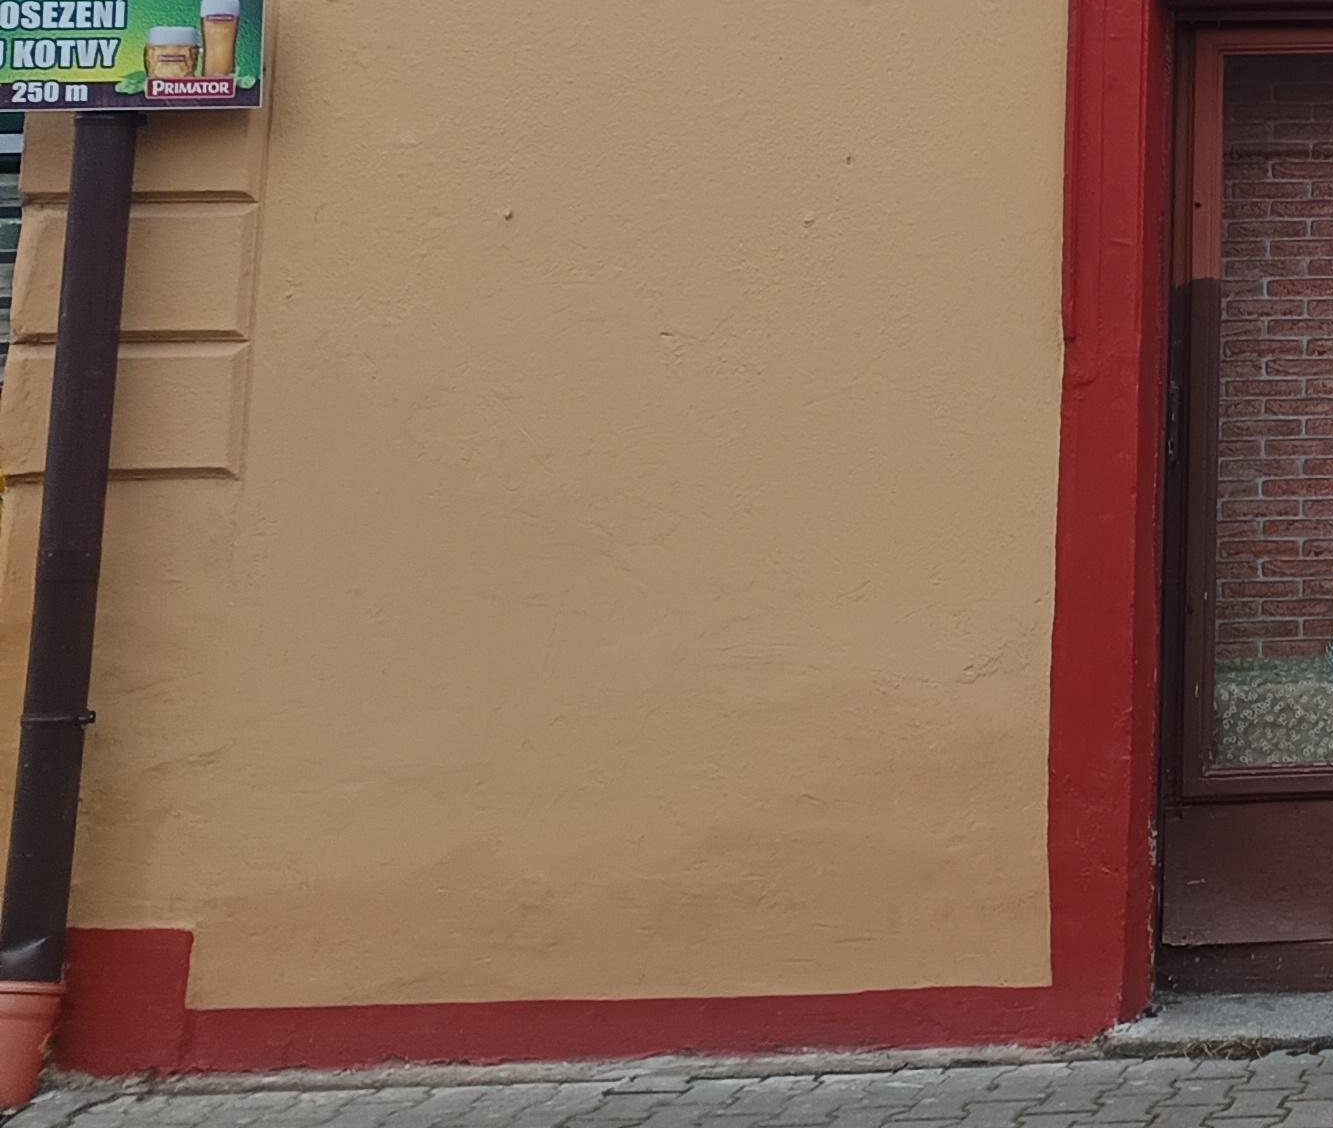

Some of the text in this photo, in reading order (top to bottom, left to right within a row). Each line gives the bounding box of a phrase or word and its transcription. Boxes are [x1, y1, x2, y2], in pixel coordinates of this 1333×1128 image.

[13, 39, 119, 68] KOTVY
[11, 82, 88, 103] 250 m
[152, 80, 229, 95] PRIMATOR
